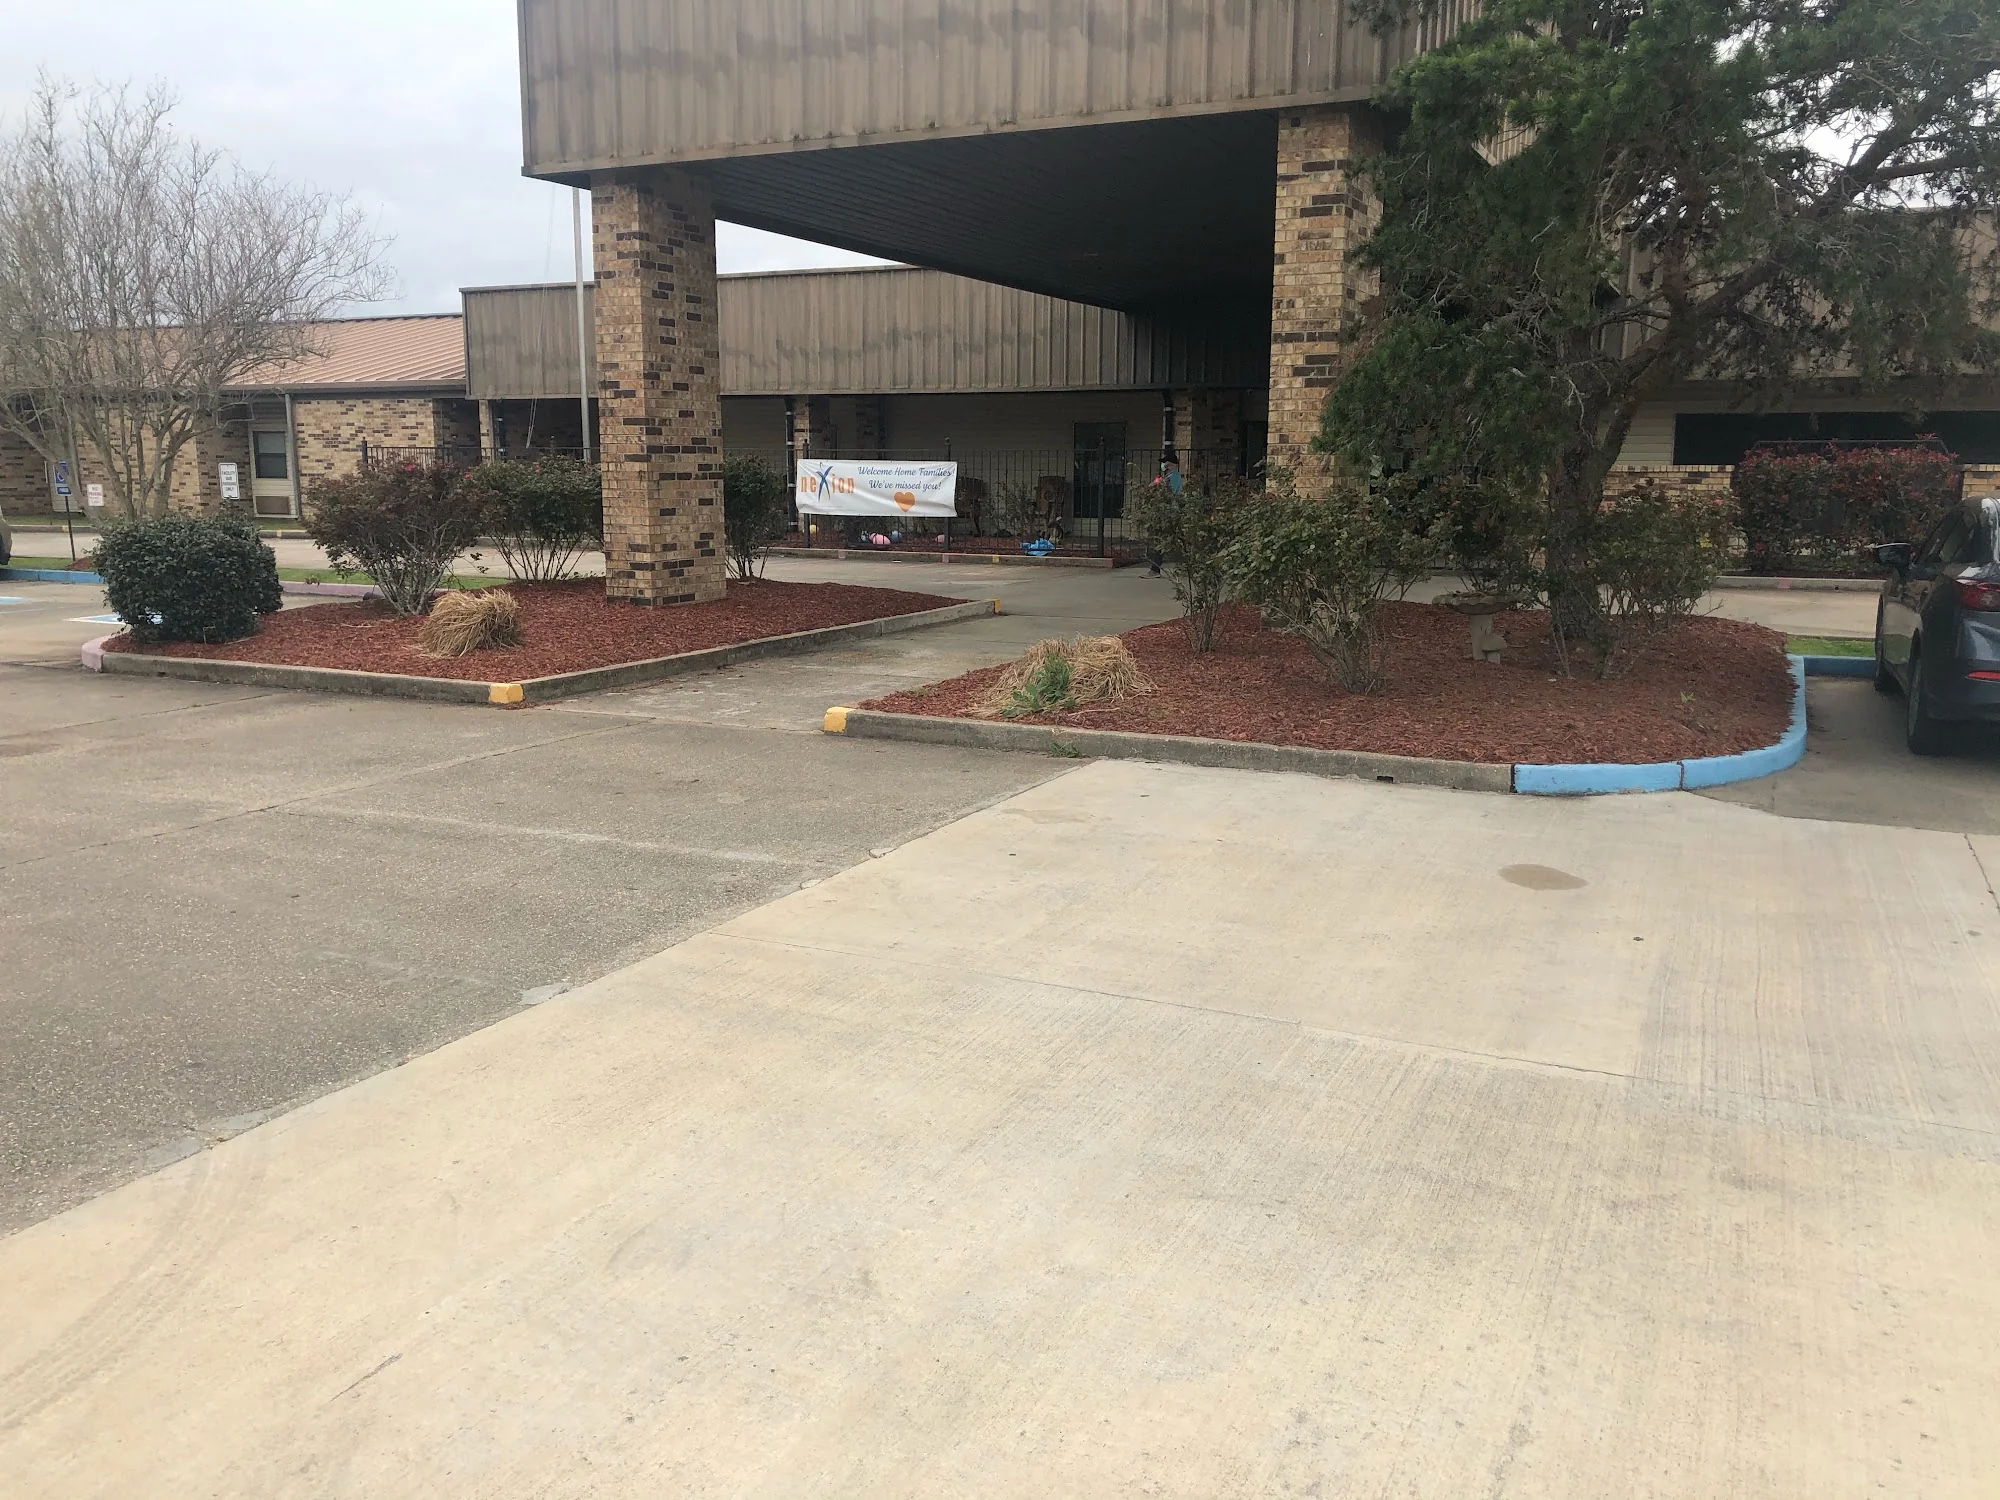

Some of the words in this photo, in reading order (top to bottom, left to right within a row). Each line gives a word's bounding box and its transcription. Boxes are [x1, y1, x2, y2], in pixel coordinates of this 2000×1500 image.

[858, 466, 893, 476] Welcome
[894, 466, 916, 476] Home
[918, 467, 955, 477] Families!
[868, 480, 894, 490] We've
[895, 481, 921, 490] missed
[922, 481, 942, 493] you!
